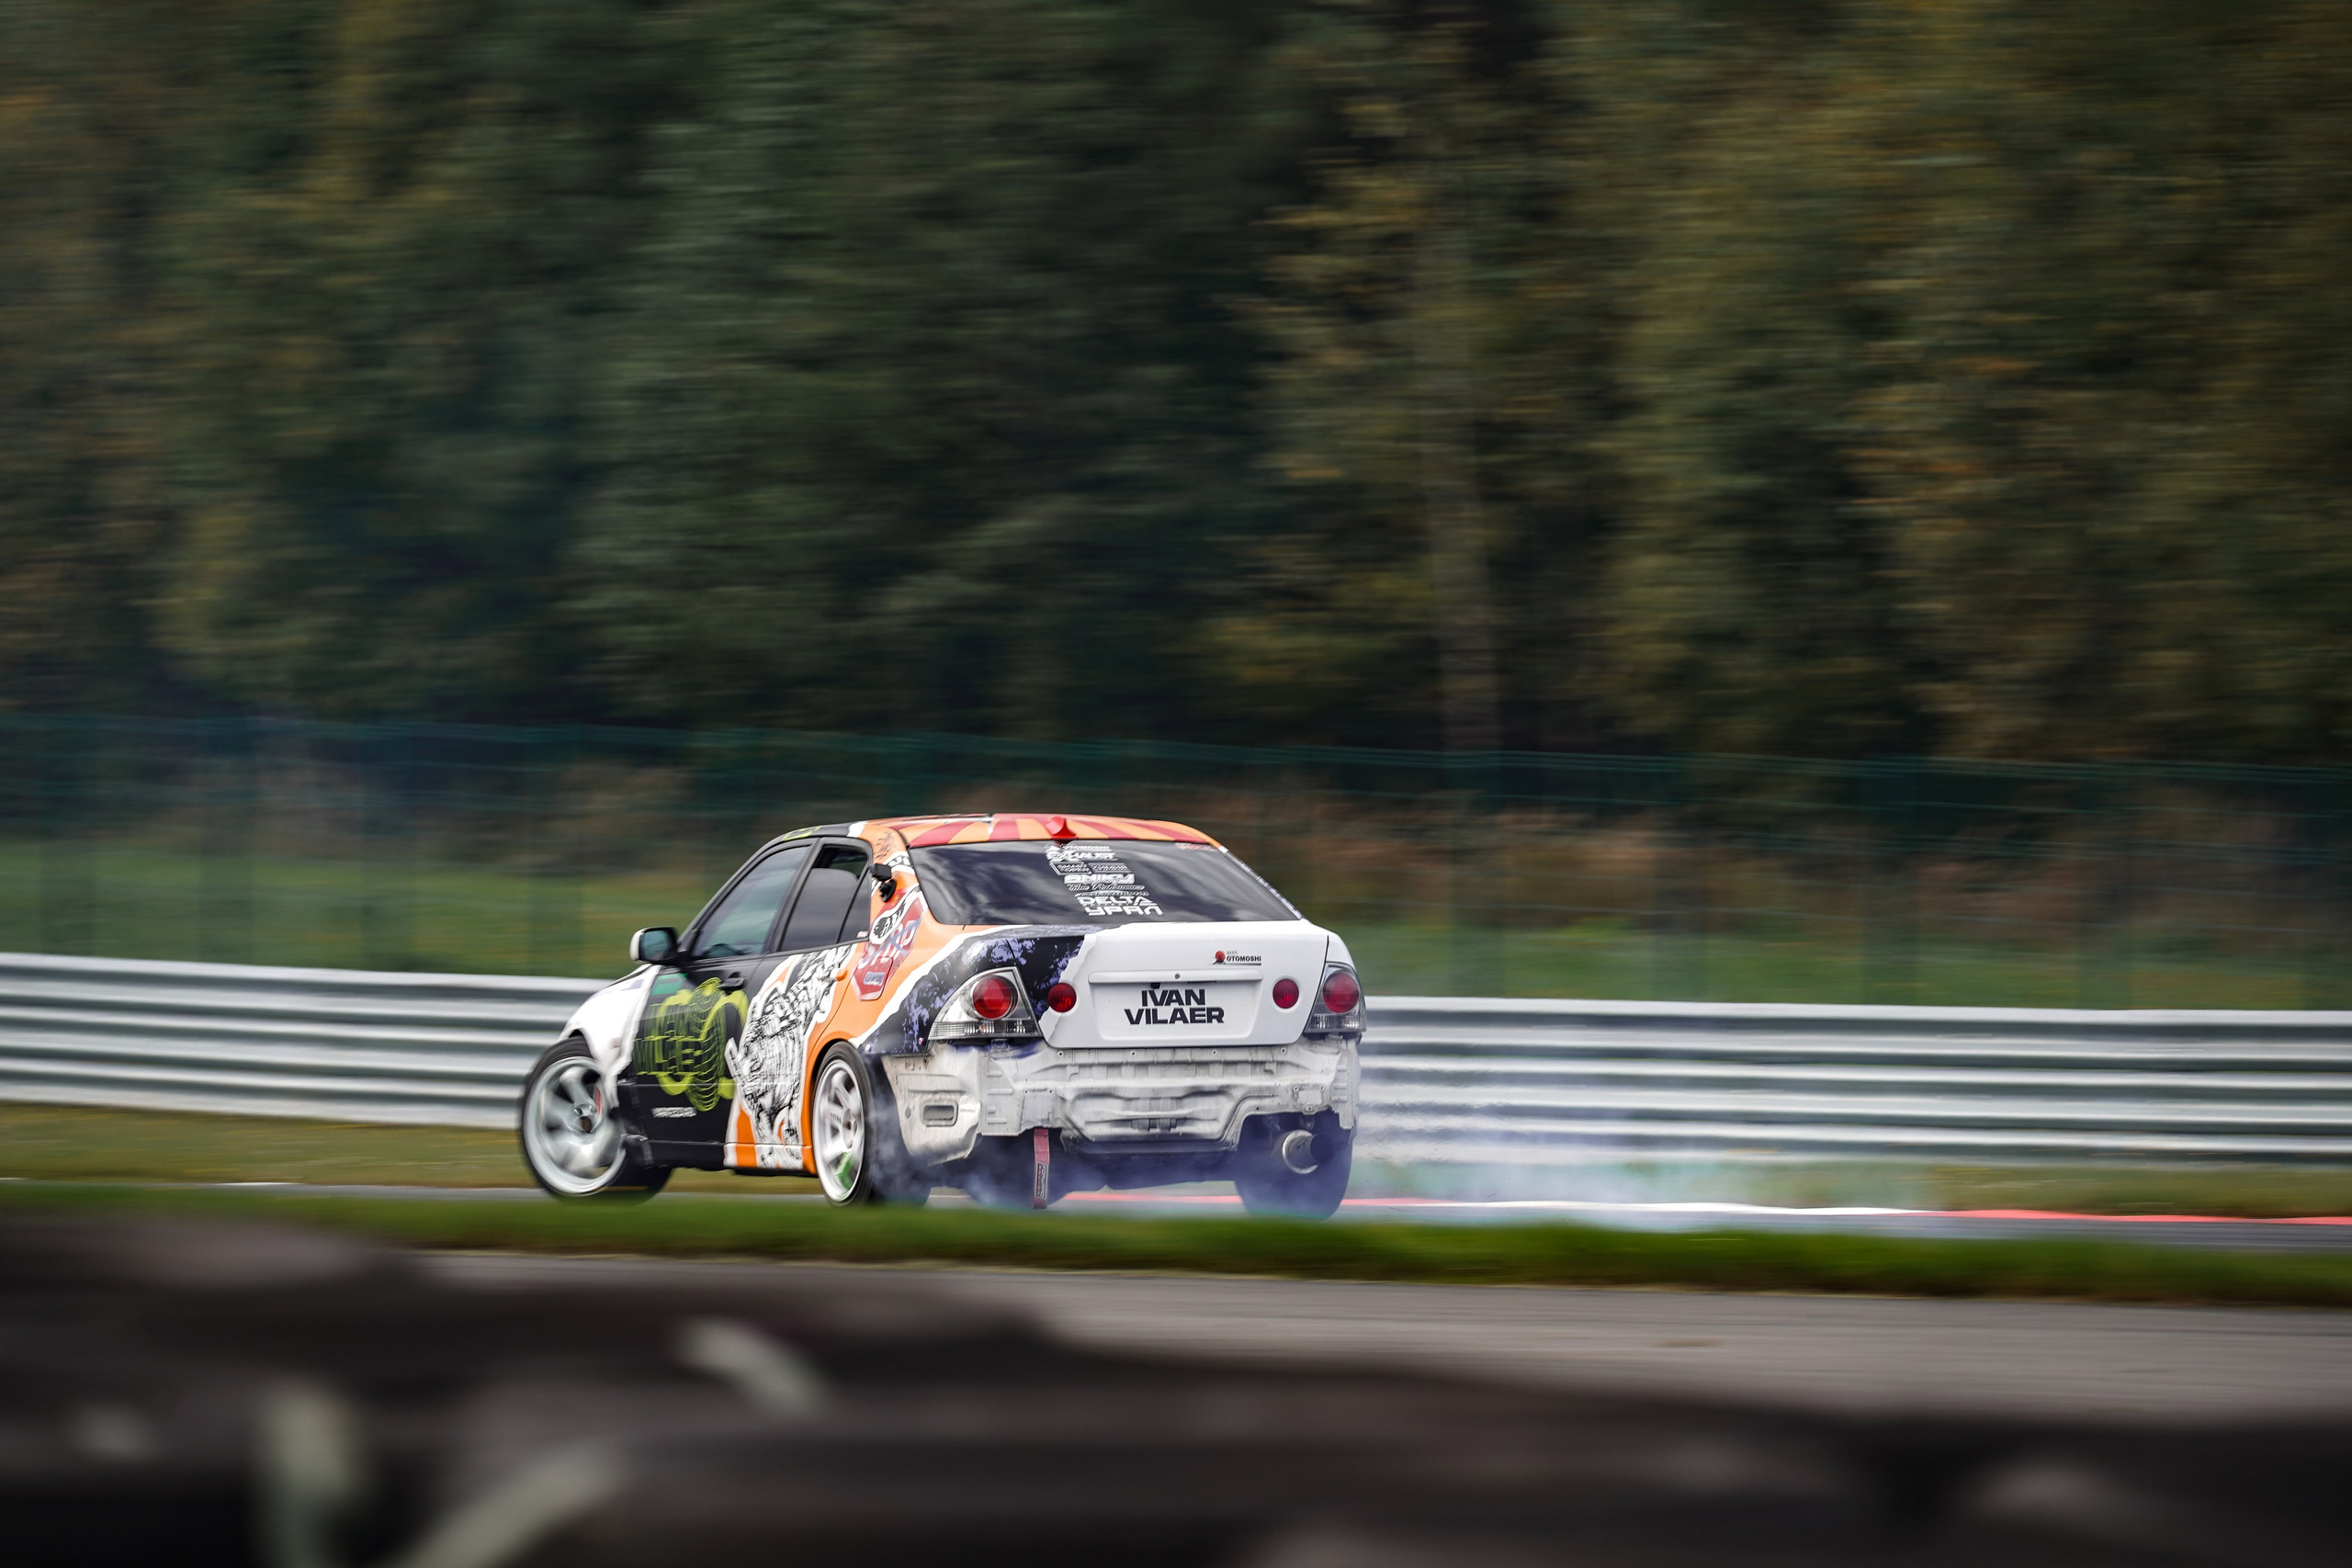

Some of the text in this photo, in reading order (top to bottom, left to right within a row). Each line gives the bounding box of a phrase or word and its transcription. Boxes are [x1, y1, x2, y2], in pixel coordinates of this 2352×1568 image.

[1077, 896, 1158, 906] DELTA
[1141, 988, 1205, 1007] IVAN
[1124, 1007, 1225, 1025] VILAER
